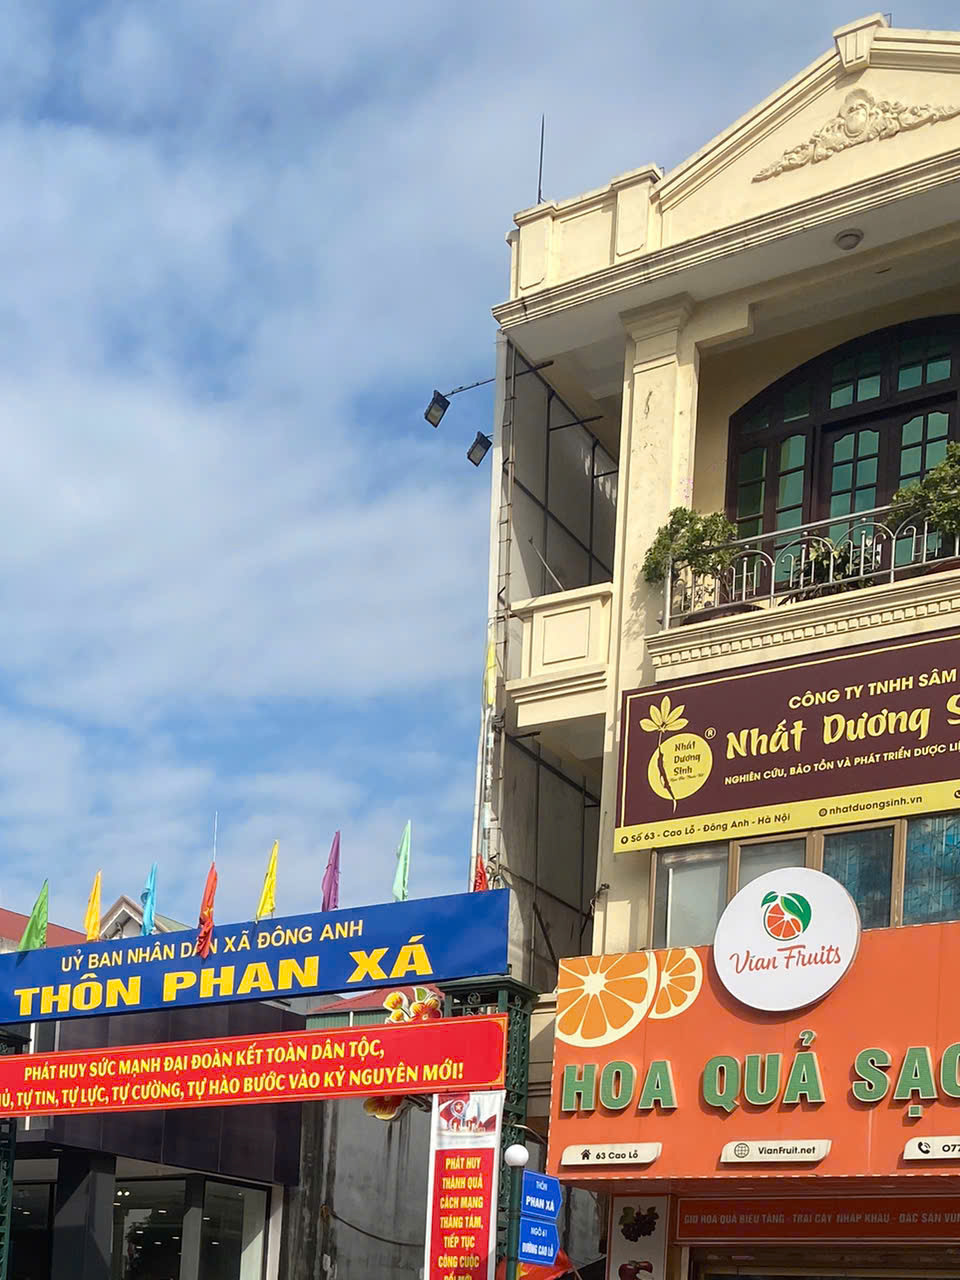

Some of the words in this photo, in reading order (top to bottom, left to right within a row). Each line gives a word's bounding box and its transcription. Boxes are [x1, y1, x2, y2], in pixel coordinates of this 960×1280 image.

[788, 690, 840, 709] CÔNG
[844, 684, 864, 700] TY
[868, 676, 913, 695] TNHH
[918, 668, 957, 687] SÂM
[726, 719, 807, 760] Nhất
[823, 708, 931, 744] Dương
[673, 766, 693, 776] Sinh
[724, 771, 761, 785] NGHIÊN
[763, 767, 787, 779] CỨU,
[789, 763, 811, 775] BẢO
[837, 756, 851, 768] VÀ
[854, 752, 880, 766] PHÁT
[883, 746, 911, 761] TRIỂN
[914, 744, 946, 757] DƯỢC
[829, 796, 923, 815] nhatduongsinh.vn
[631, 831, 642, 843] Số
[644, 832, 655, 841] 63
[663, 829, 682, 838] Cao
[731, 819, 749, 829] Anh
[757, 816, 771, 825] Hà
[774, 813, 791, 824] Nội
[88, 950, 123, 970] BAN
[127, 941, 175, 965] NHÂN
[224, 930, 251, 952] XÃ
[257, 925, 312, 949] ĐÔNG
[320, 919, 363, 941] ANH
[777, 944, 841, 969] Fruits
[14, 973, 141, 1017] THÔN
[162, 956, 320, 1003] PHAN
[346, 935, 433, 983] XÁ
[24, 1061, 56, 1081] PHÁT
[59, 1063, 87, 1079] HUY
[89, 1057, 116, 1077] SỨC
[118, 1057, 160, 1077] MẠNH
[163, 1055, 188, 1075] ĐẠI
[191, 1048, 232, 1070] ĐOÀN
[235, 1042, 263, 1066] KẾT
[266, 1041, 307, 1064] TOÀN
[311, 1038, 345, 1060] DÂN
[349, 1035, 385, 1061] TỘC,
[561, 1058, 678, 1113] HOA
[702, 1029, 826, 1113] QUẢ
[16, 1089, 34, 1110] TỰ
[35, 1090, 59, 1107] TIN,
[62, 1086, 79, 1107] TỰ
[81, 1085, 109, 1106] LỰC,
[112, 1083, 129, 1104] TỰ
[131, 1079, 184, 1100] CƯỜNG,
[187, 1077, 207, 1100] TỰ
[209, 1074, 240, 1095] HÀO
[243, 1070, 285, 1093] BƯỚC
[289, 1068, 320, 1089] VÀO
[323, 1065, 345, 1087] KỶ
[349, 1061, 419, 1086] NGUYÊN
[422, 1057, 463, 1081] MỚI!
[595, 1151, 606, 1160] 63
[608, 1151, 627, 1160] Cao
[757, 1146, 816, 1156] VianFruit.net
[445, 1155, 465, 1170] PHÁT
[466, 1156, 481, 1169] HUY
[467, 1173, 483, 1189] QUẢ
[439, 1194, 459, 1209] CÁCH
[460, 1196, 484, 1211] MẠNG
[525, 1196, 545, 1210] PHAN
[545, 1201, 555, 1212] XÁ
[440, 1213, 464, 1228] THÁNG
[443, 1232, 459, 1248] TIẾP
[461, 1236, 476, 1251] TỤC
[438, 1252, 458, 1268] CÔNG
[459, 1254, 480, 1270] CUỘC
[538, 1246, 548, 1257] CAO
